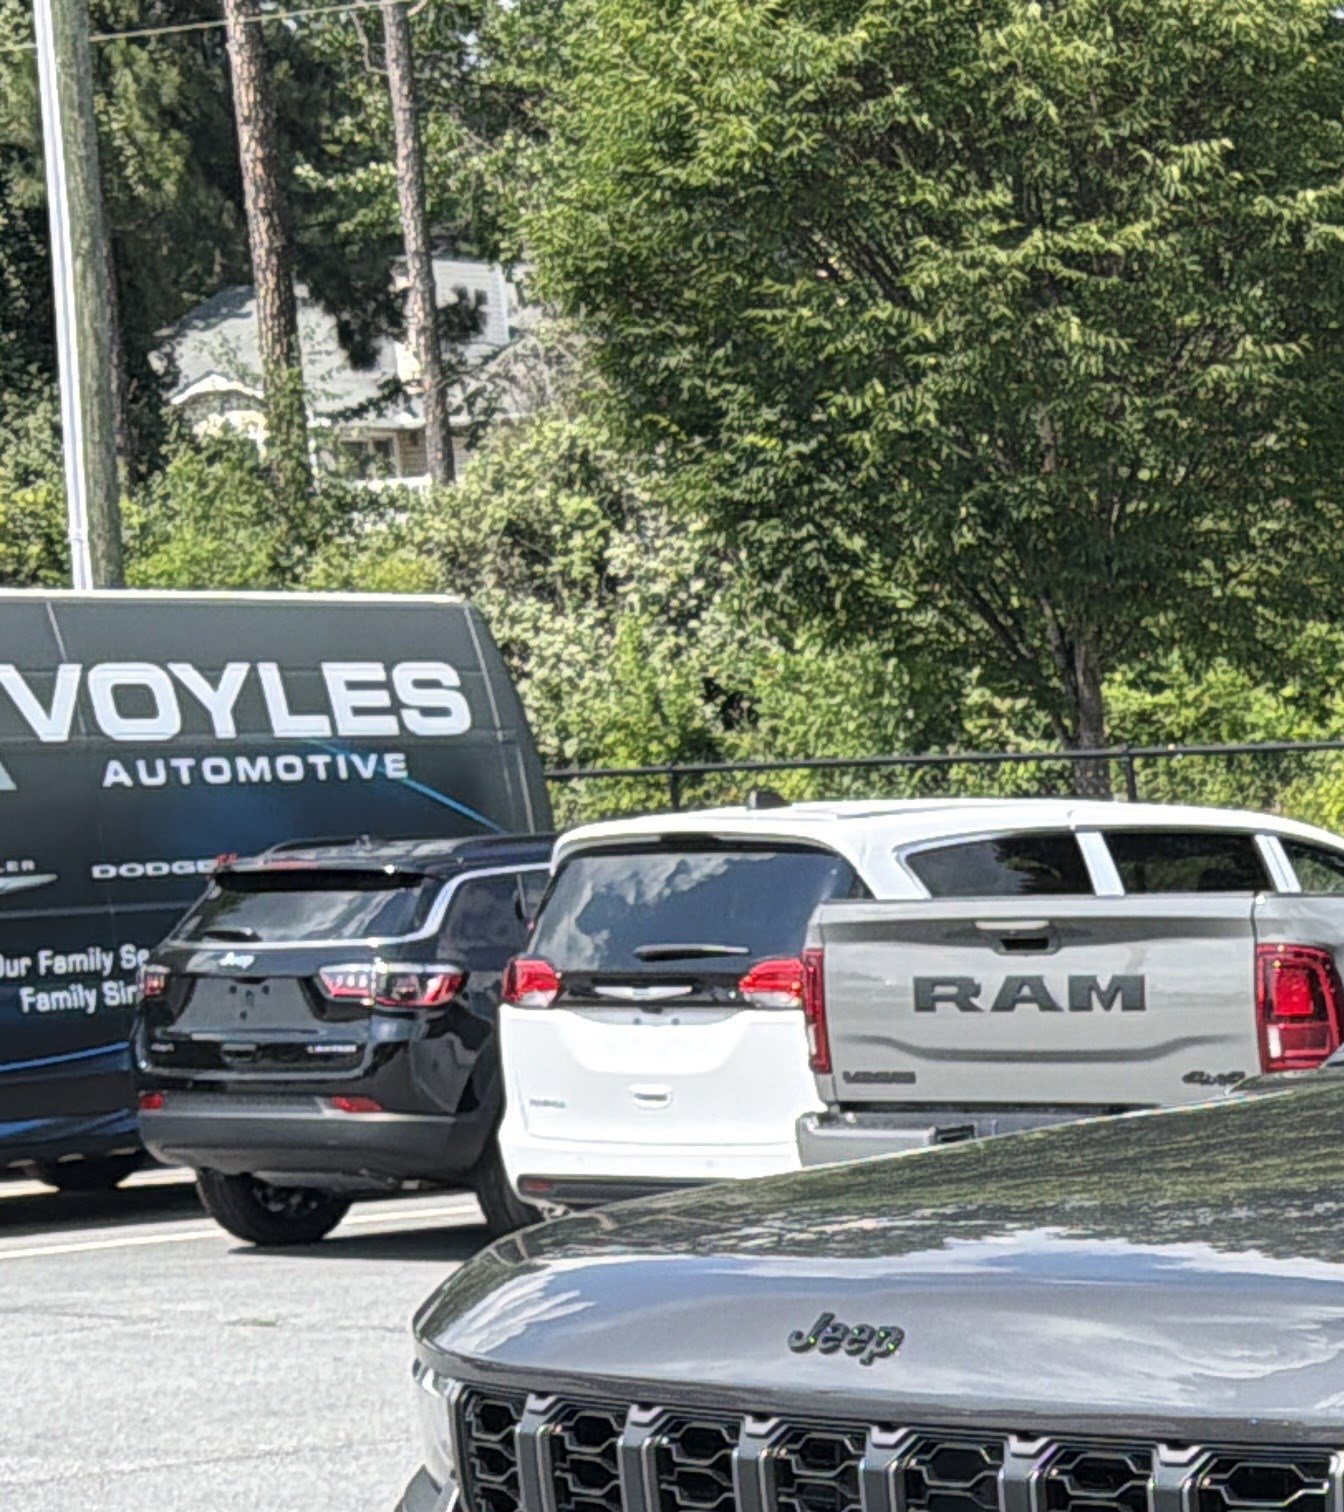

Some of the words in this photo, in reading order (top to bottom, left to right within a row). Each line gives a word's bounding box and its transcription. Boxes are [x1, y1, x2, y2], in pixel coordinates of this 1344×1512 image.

[0, 661, 472, 742] VOYLES
[102, 753, 409, 788] AUTOMOTIVE
[0, 953, 32, 978] ur
[38, 946, 114, 977] Family
[120, 943, 150, 970] Se
[19, 983, 97, 1014] Family
[912, 974, 1148, 1013] RAM
[787, 1311, 906, 1367] Jeep
